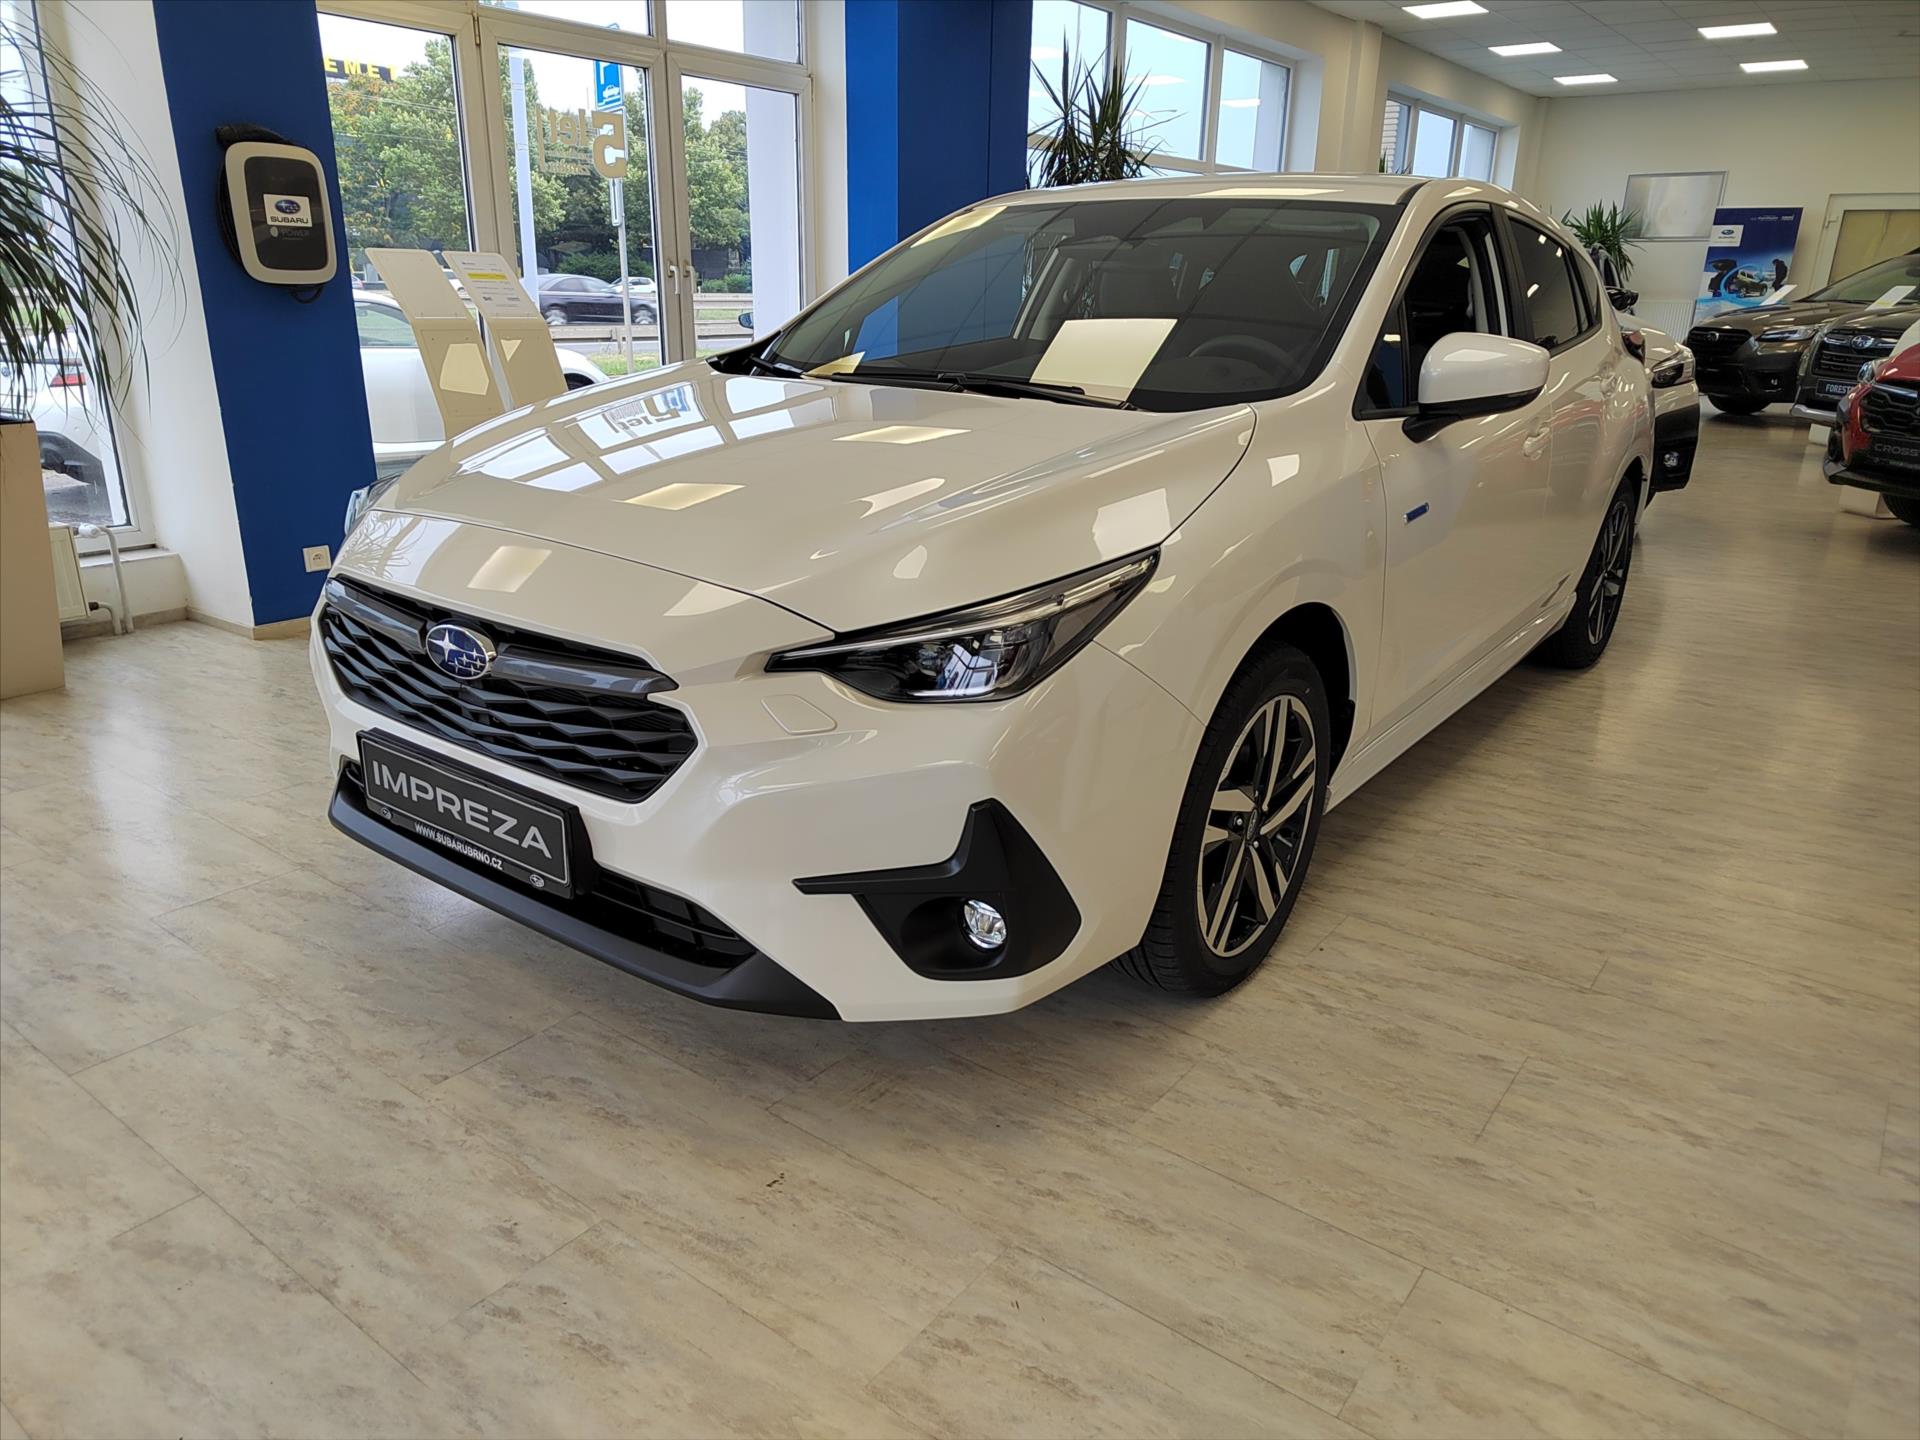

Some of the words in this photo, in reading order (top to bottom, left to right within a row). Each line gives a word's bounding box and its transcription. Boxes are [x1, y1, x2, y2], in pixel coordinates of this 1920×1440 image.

[270, 216, 309, 224] SUBARU
[1874, 443, 1919, 457] CROSS
[372, 760, 552, 859] IMPREZA
[414, 821, 503, 871] WWW.SUBARUBRNO.CZ
